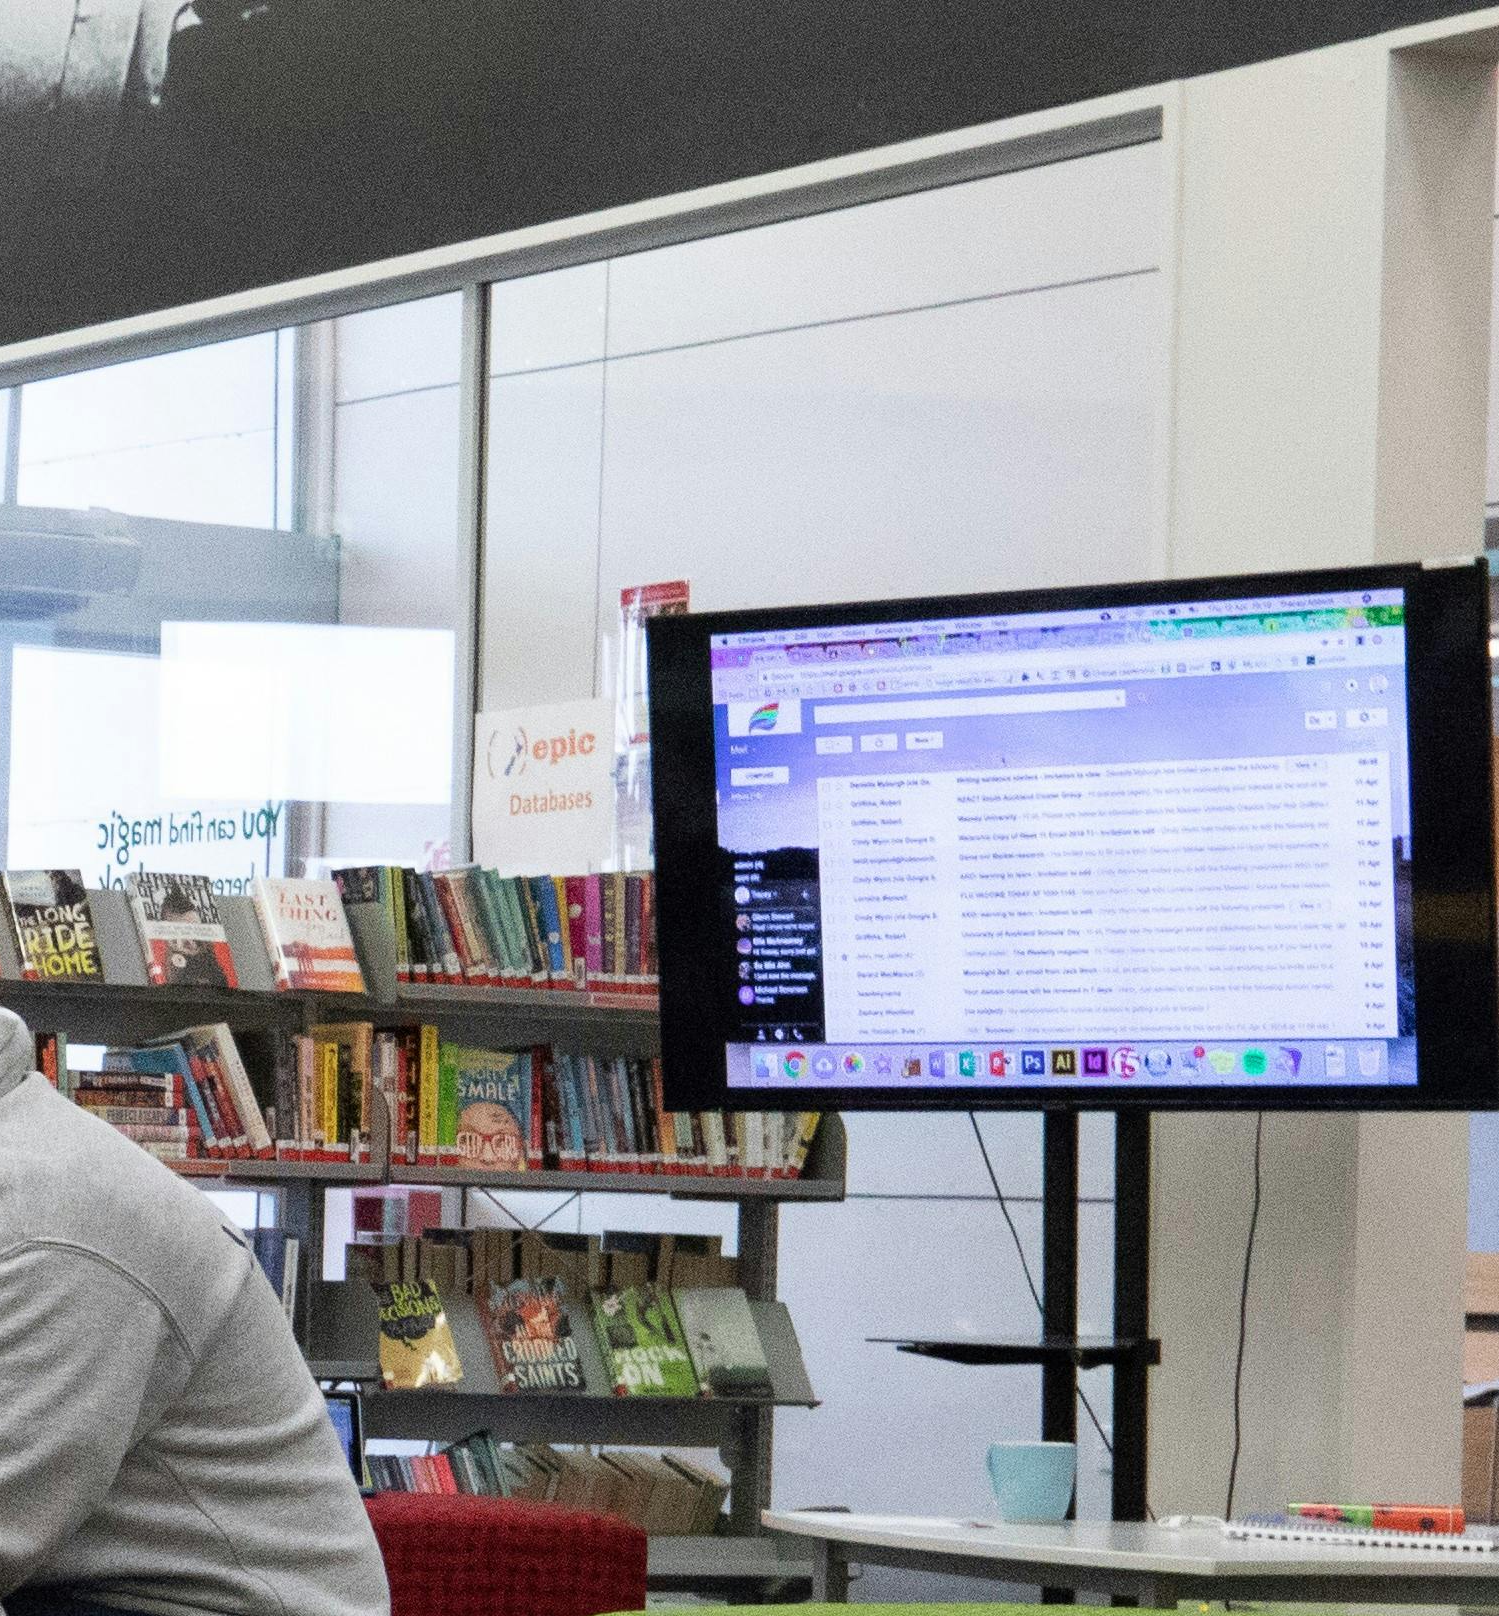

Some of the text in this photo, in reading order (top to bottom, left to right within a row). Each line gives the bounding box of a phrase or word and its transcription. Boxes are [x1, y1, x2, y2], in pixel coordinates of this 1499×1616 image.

[532, 729, 596, 766] epic
[508, 788, 593, 818] Databases
[276, 887, 328, 906] LAST
[35, 904, 86, 925] LONG
[278, 906, 338, 922] THING
[24, 922, 95, 955] RIDE
[31, 951, 97, 977] HOME
[457, 1081, 517, 1102] SMALE
[389, 1281, 423, 1302] BAD
[502, 1336, 577, 1364] CROOKED
[514, 1362, 580, 1390] SAINTS
[623, 1362, 665, 1387] ON
